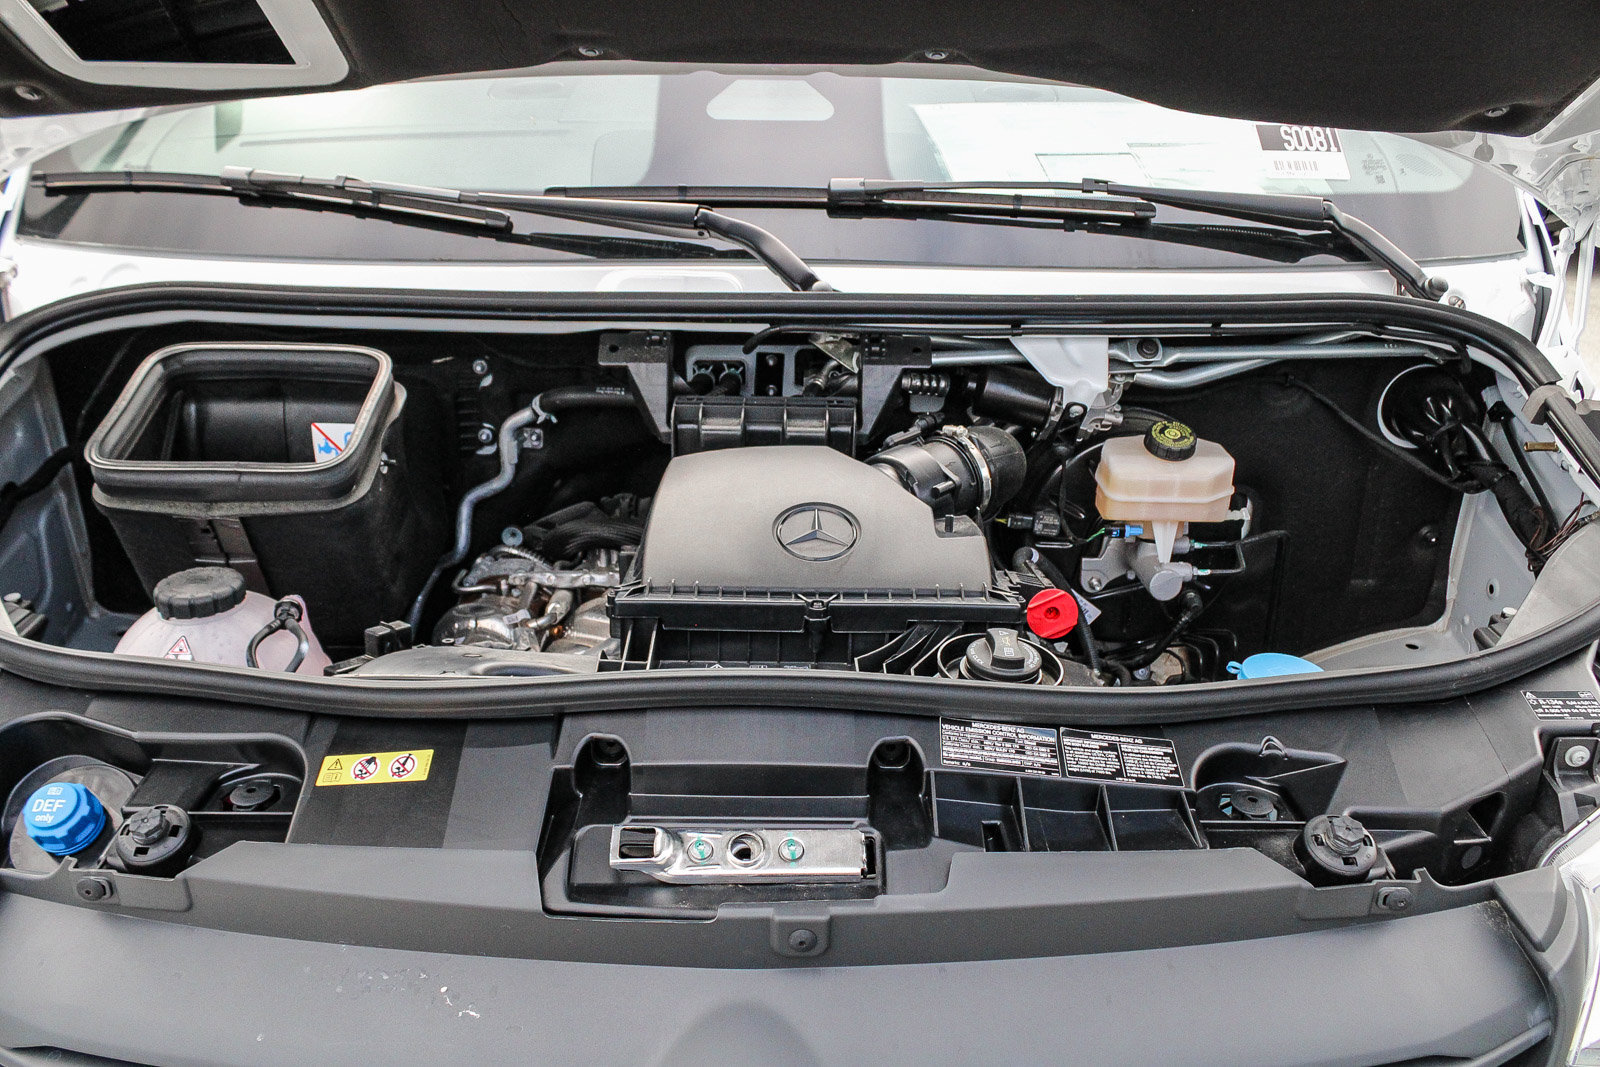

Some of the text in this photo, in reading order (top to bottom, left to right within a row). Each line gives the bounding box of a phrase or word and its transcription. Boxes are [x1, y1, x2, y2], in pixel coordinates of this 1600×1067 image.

[1280, 126, 1338, 152] S0081
[31, 798, 66, 813] DEF
[34, 813, 55, 824] only
